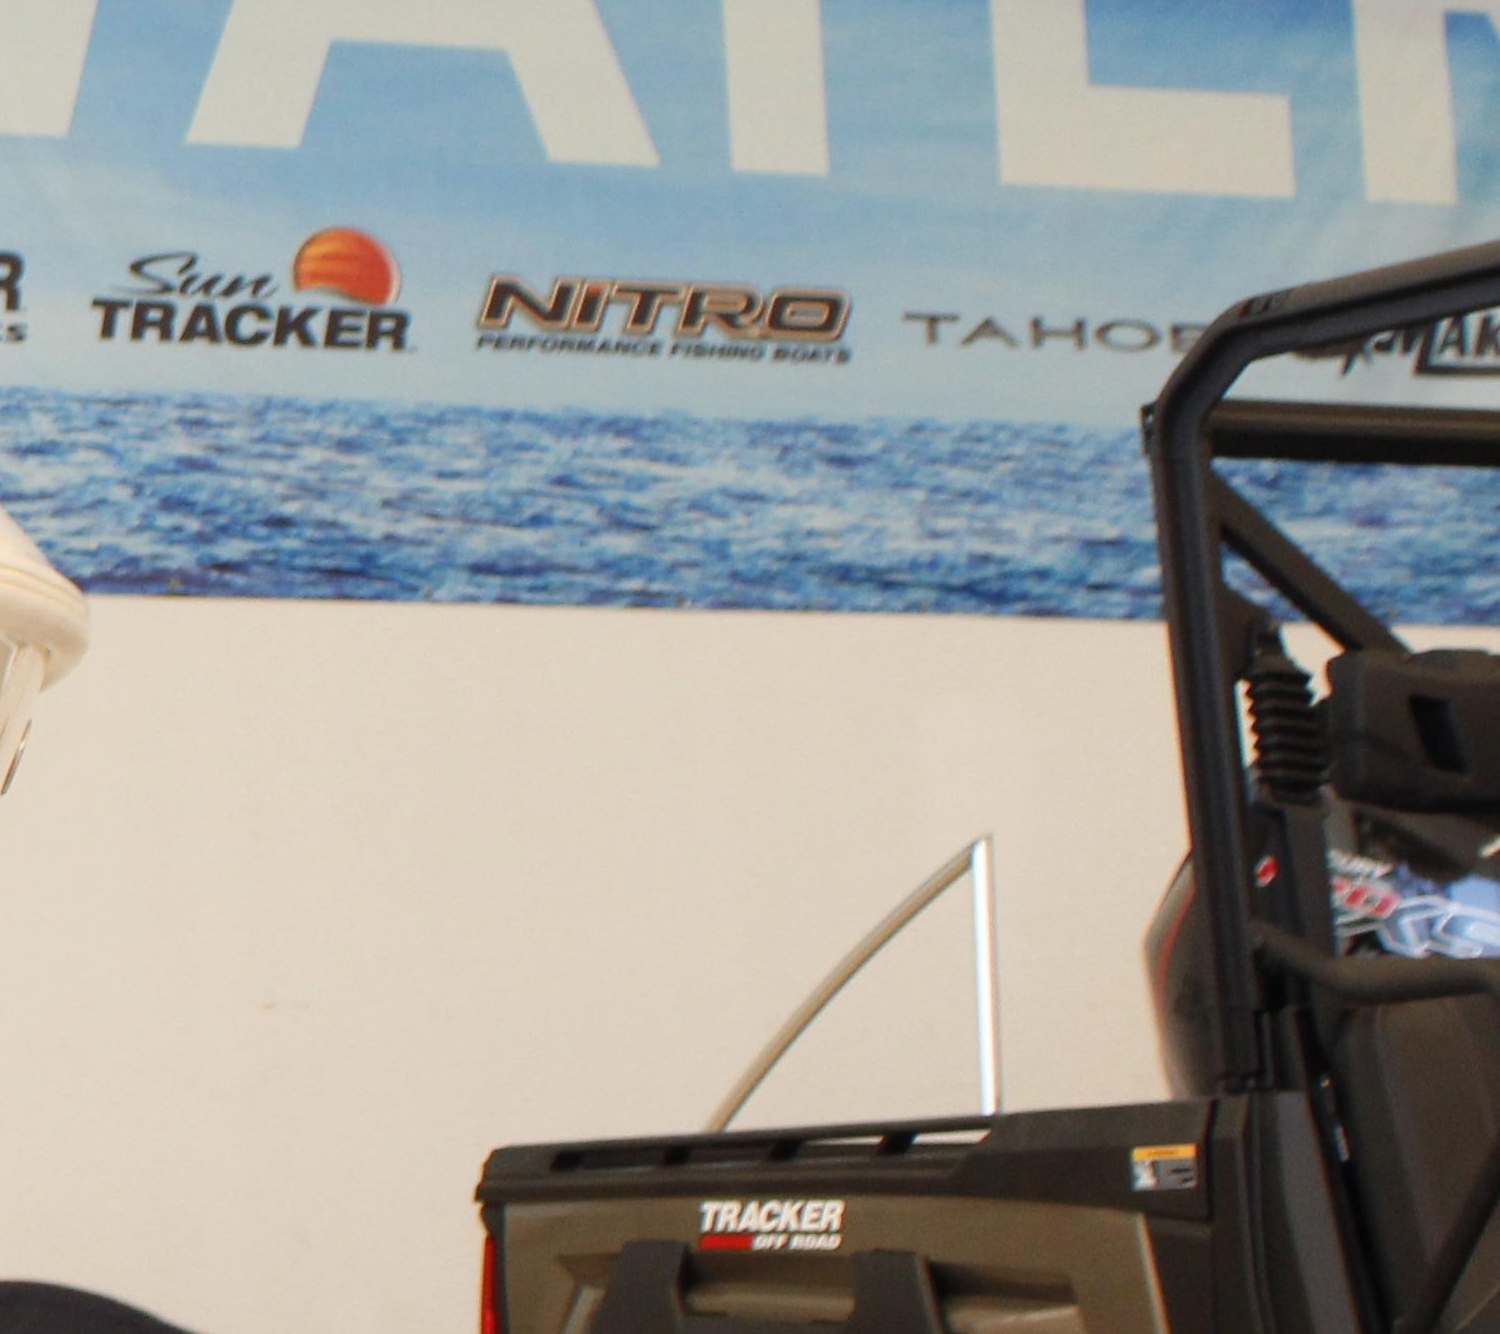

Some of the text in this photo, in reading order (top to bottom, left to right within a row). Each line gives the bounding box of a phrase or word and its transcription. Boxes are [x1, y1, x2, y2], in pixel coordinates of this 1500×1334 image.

[108, 249, 279, 302] Sun
[91, 296, 411, 352] TRACKER
[476, 273, 852, 343] NITRO
[476, 333, 852, 365] PERFORMANCE FISHING BOATS
[700, 1199, 846, 1234] TRACKER
[752, 1233, 843, 1251] OFF ROAD
